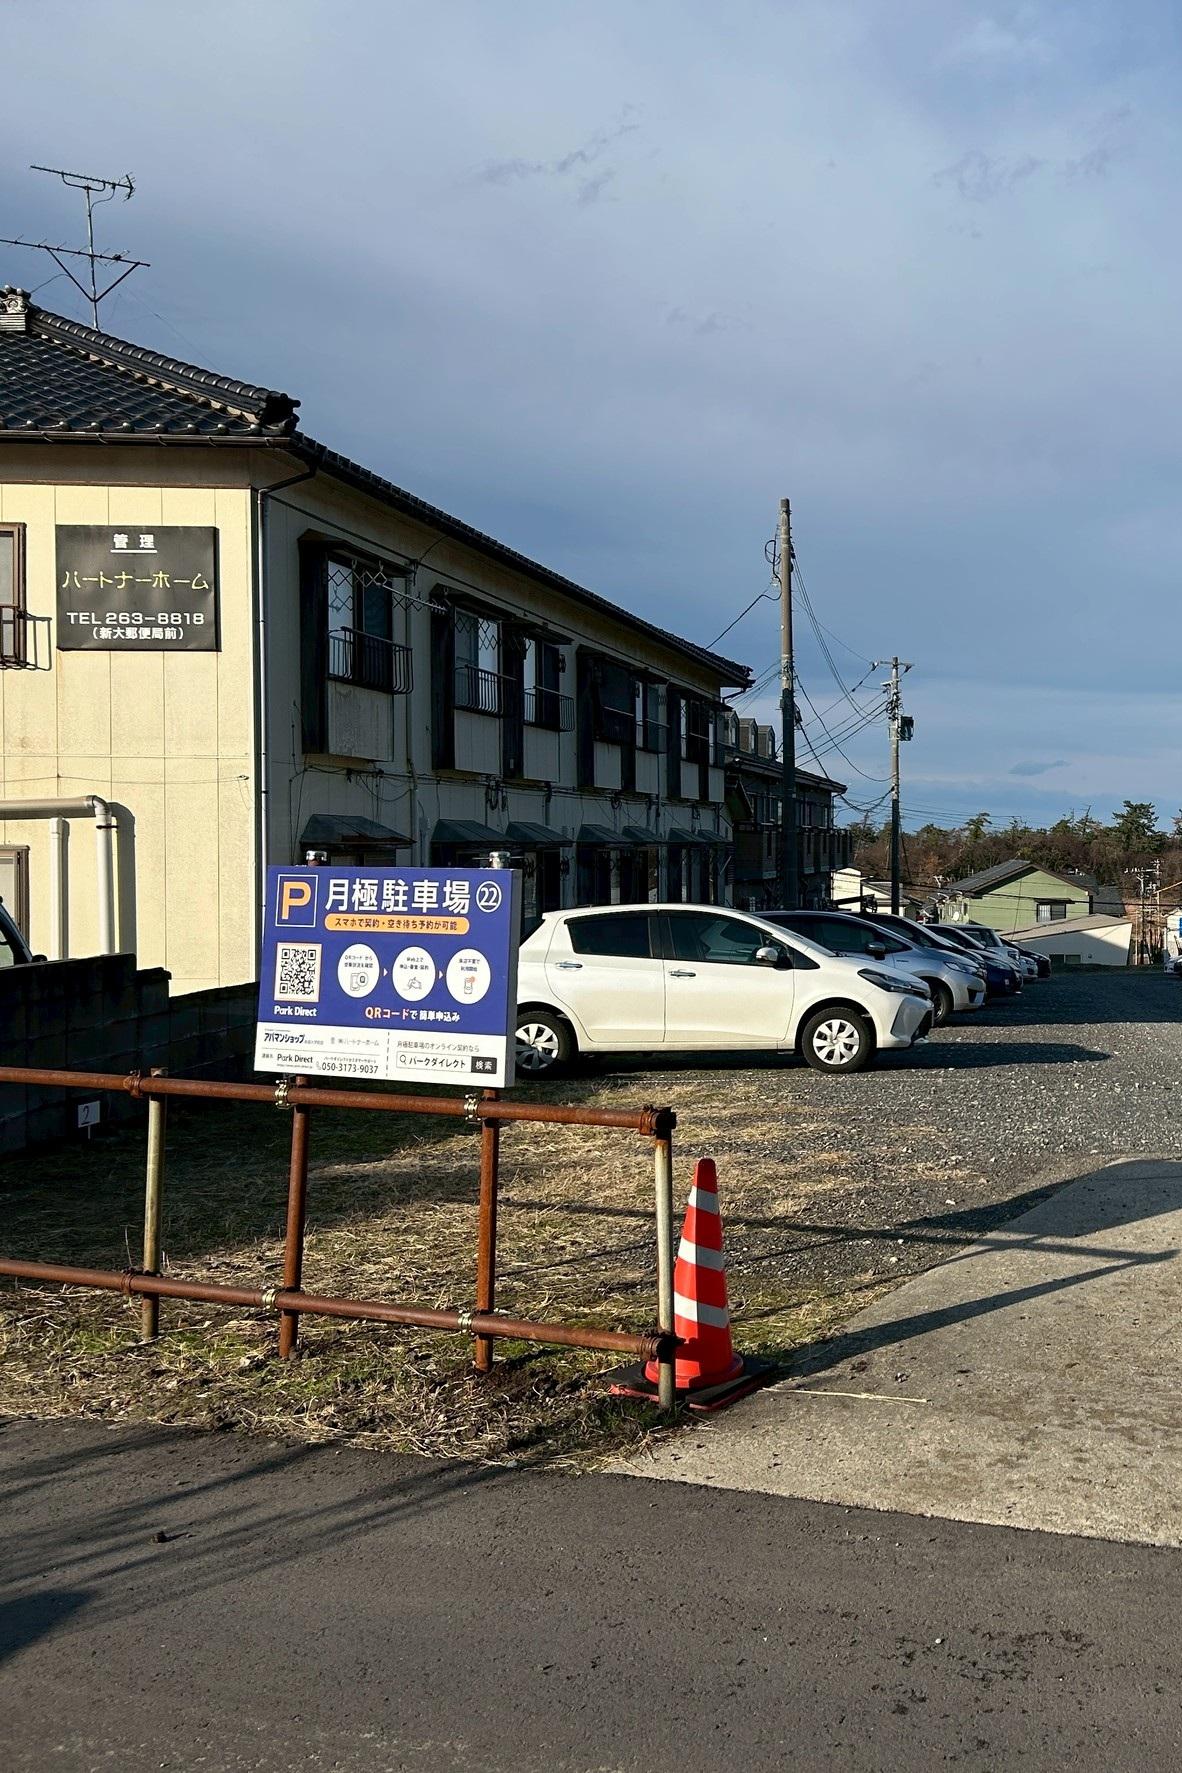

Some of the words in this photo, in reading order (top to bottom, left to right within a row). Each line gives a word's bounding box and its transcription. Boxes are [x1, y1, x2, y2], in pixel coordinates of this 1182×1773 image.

[113, 534, 155, 548] 管理
[62, 570, 209, 590] パートナーホーム
[66, 612, 101, 624] TEL
[106, 612, 204, 624] 263-8818
[92, 627, 184, 640] (新大郵便局前)
[281, 881, 311, 920] P
[325, 878, 470, 914] 月極駐車場
[274, 1006, 292, 1015] Park
[294, 1006, 317, 1017] Direct
[264, 1032, 305, 1043] アパマンショップ
[277, 1053, 293, 1062] Park
[294, 1054, 313, 1063] Direct
[409, 1056, 466, 1069] パークダイレクト
[322, 1062, 378, 1074] 050-3173-9037
[475, 1060, 492, 1071] 検索
